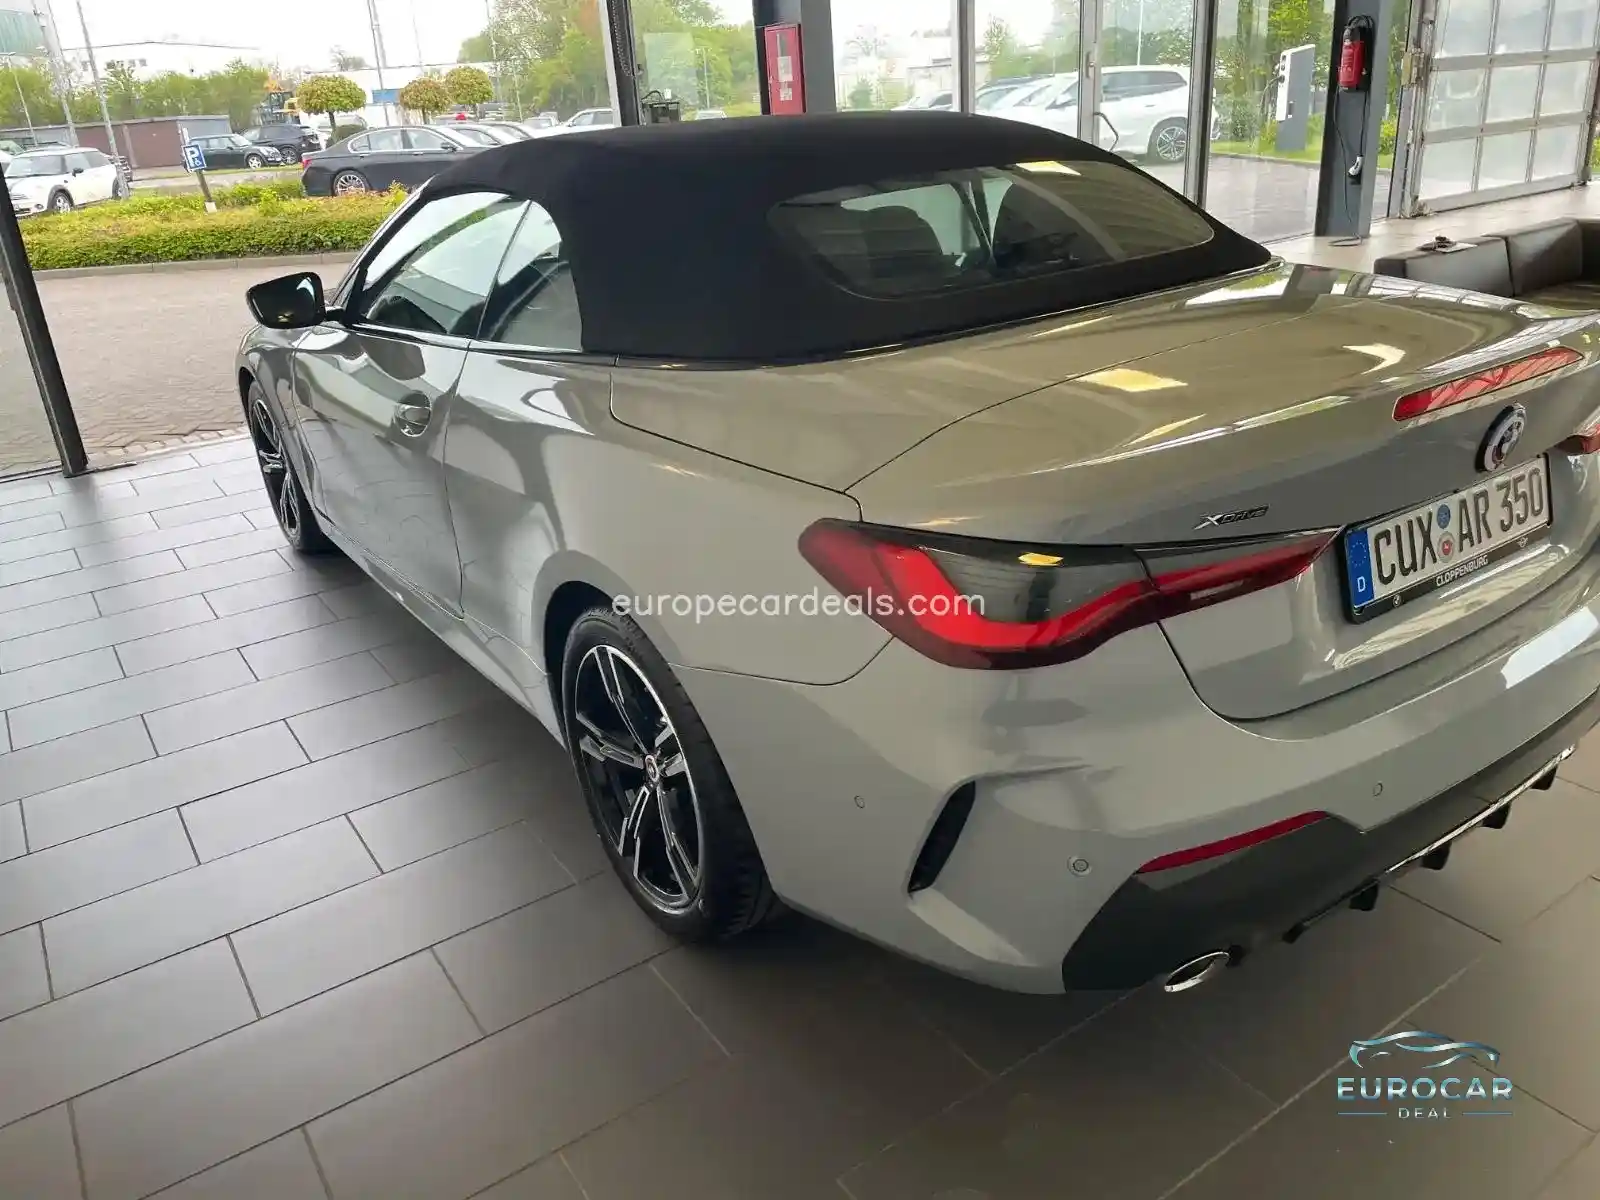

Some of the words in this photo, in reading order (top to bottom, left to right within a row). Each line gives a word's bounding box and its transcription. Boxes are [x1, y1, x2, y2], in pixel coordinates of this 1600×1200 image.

[185, 147, 200, 168] P
[1374, 511, 1437, 585] CUX
[1459, 489, 1492, 552] AR
[1495, 467, 1543, 532] 350
[1357, 576, 1366, 592] D
[1436, 555, 1488, 587] CLOPPENBURG
